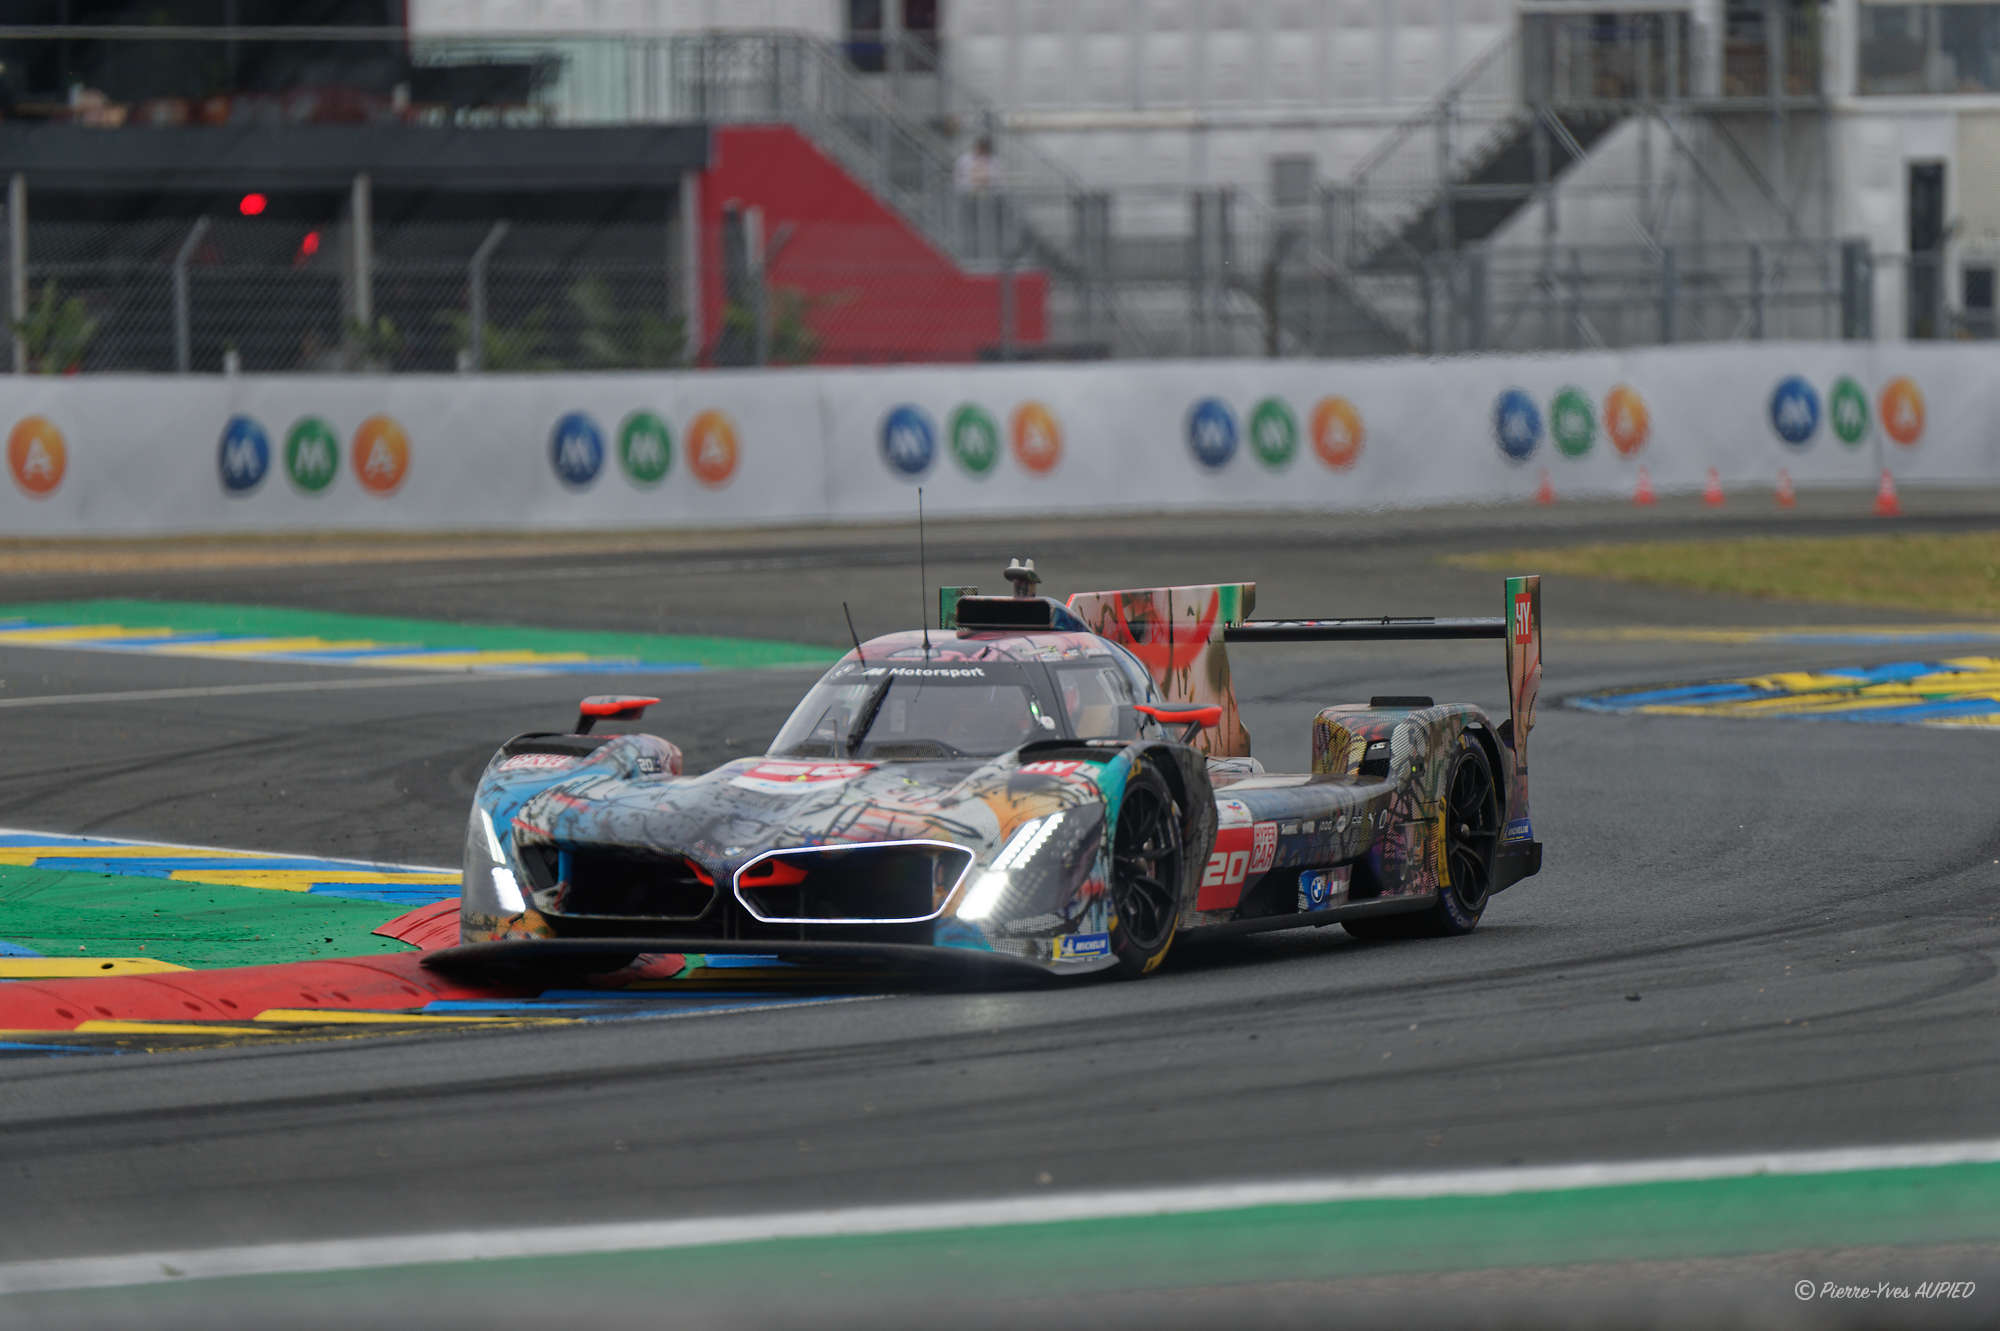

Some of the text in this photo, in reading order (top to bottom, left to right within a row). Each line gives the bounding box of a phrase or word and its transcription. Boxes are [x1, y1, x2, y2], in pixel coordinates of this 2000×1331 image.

[1516, 602, 1531, 635] HY
[888, 667, 985, 678] Motorsport
[1255, 826, 1275, 843] HYPER
[1202, 851, 1250, 887] 20
[1251, 843, 1274, 869] CAR
